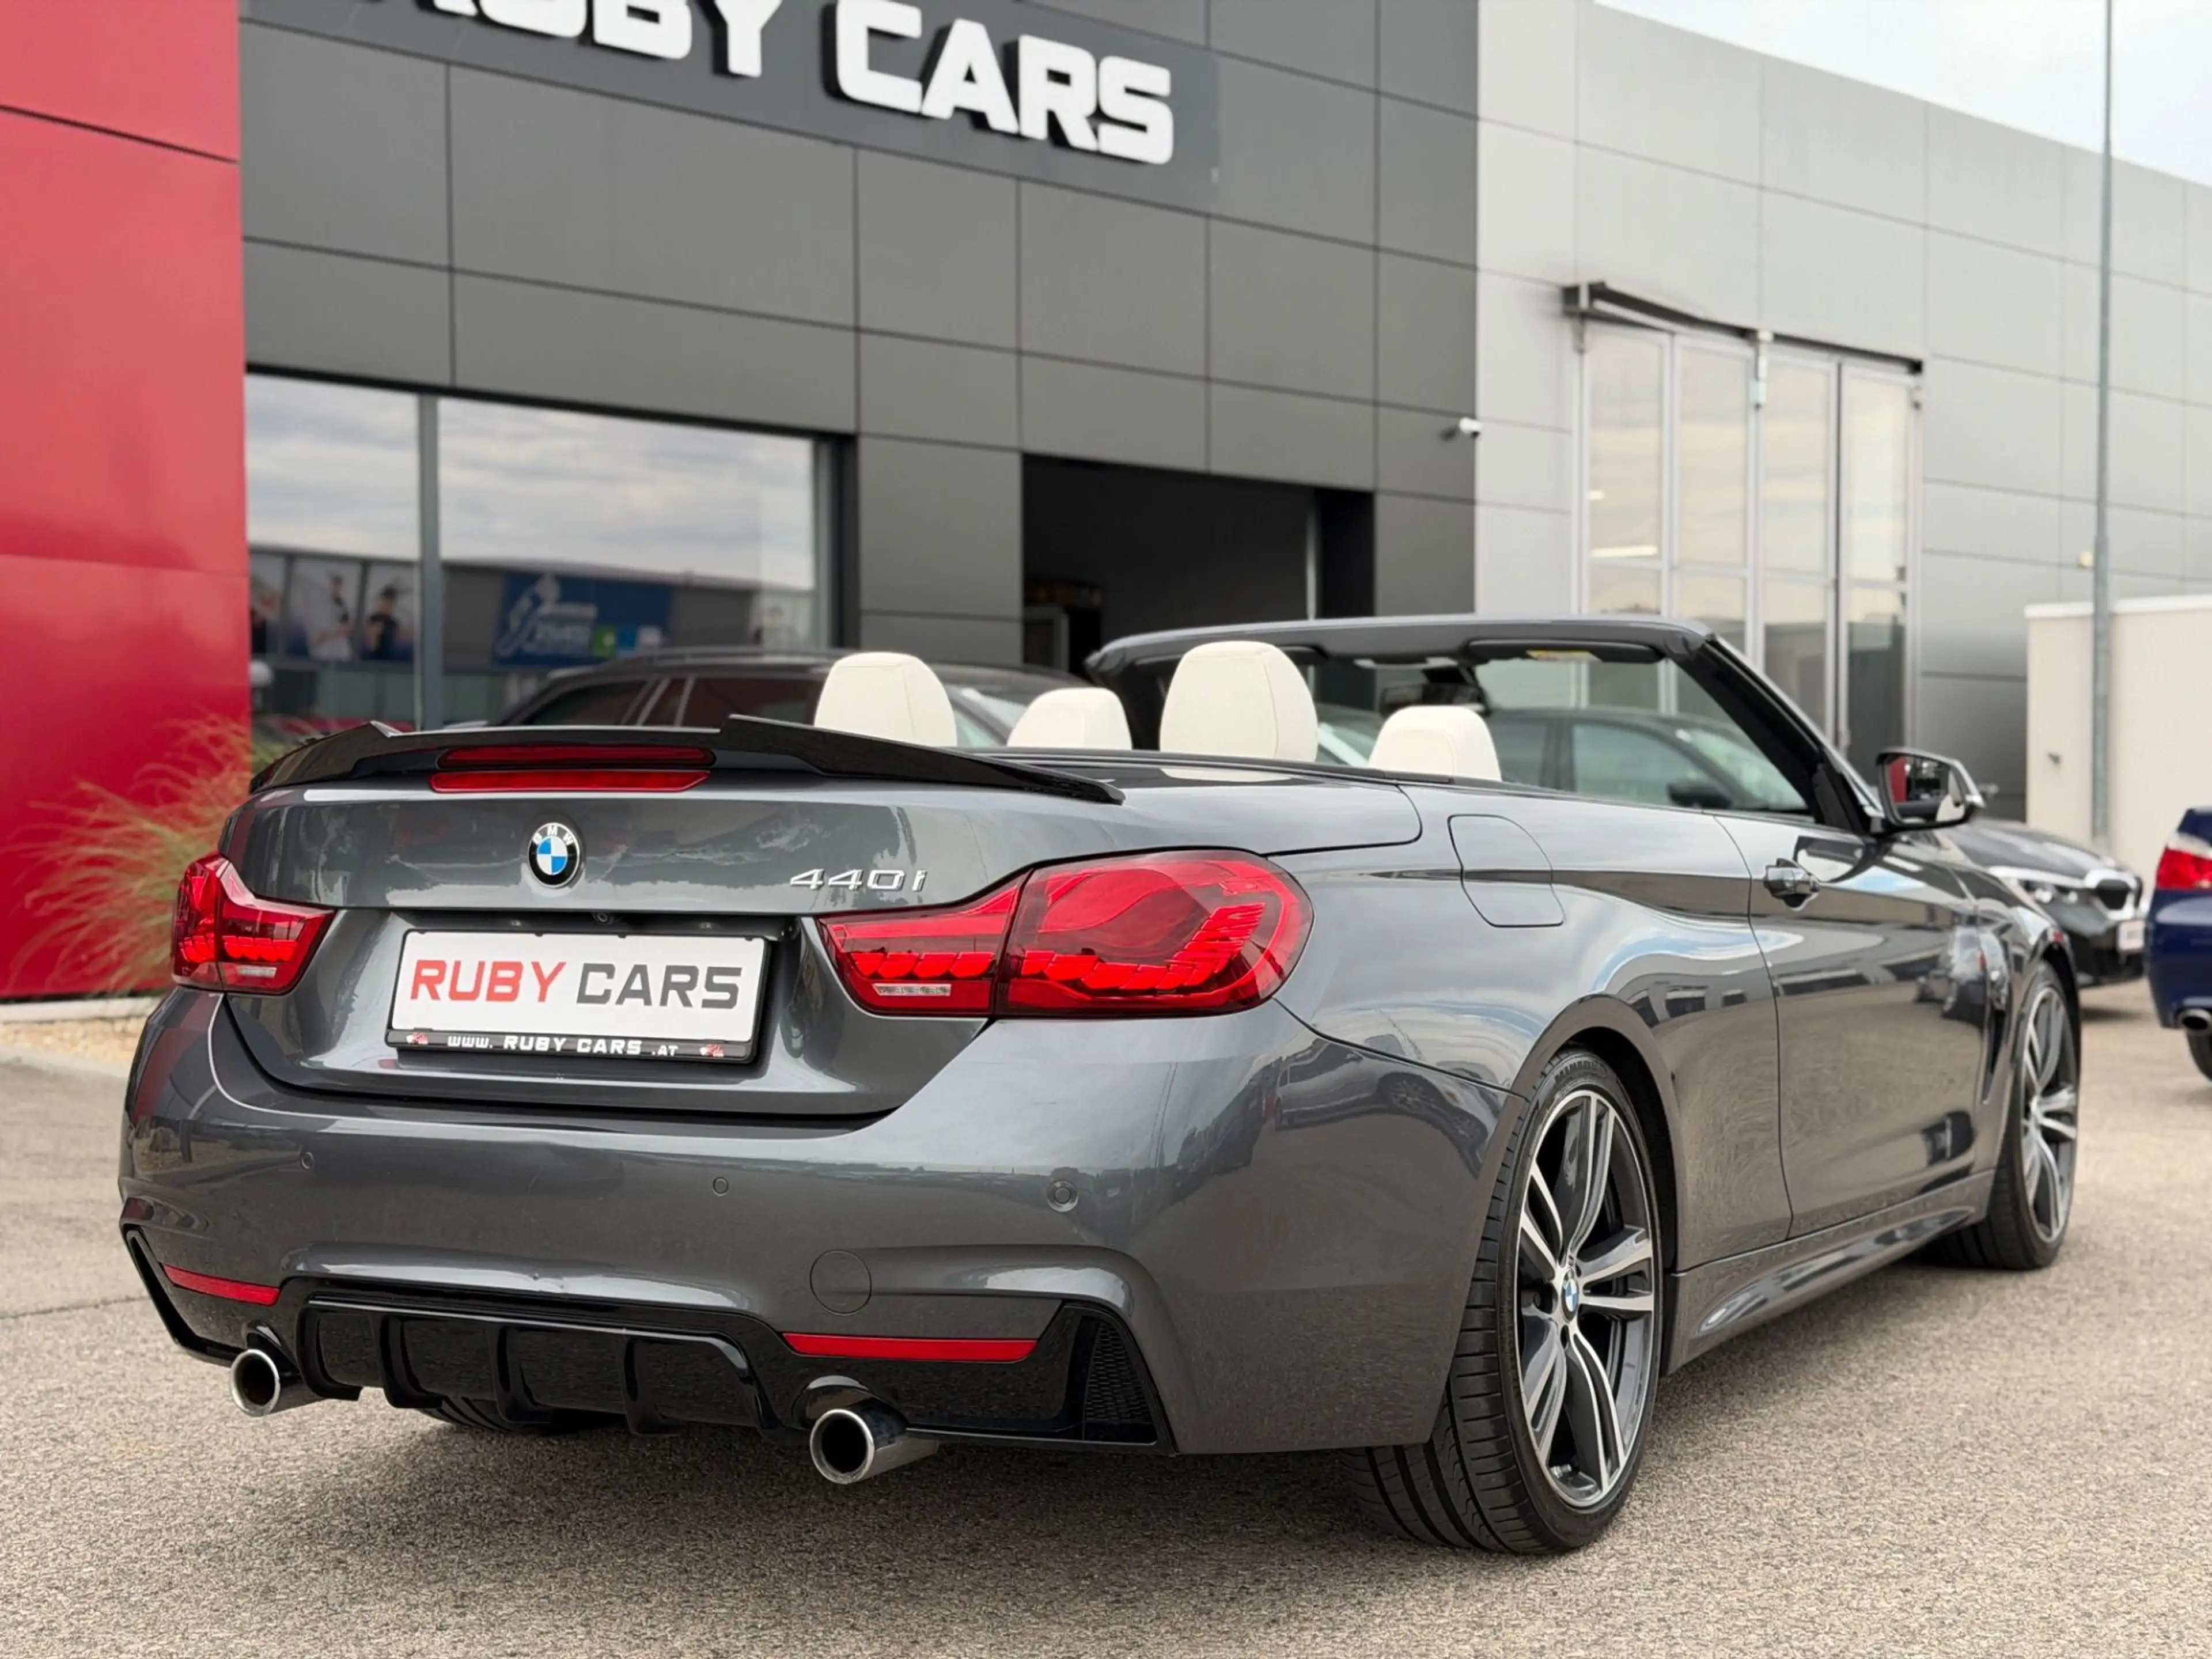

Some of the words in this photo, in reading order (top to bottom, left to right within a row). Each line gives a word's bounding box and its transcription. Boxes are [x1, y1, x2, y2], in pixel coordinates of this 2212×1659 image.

[830, 0, 1173, 164] CARS
[790, 868, 927, 892] 440i
[410, 959, 567, 1002] RUBY
[576, 963, 743, 1009] CARS
[503, 1035, 567, 1052] RUBY
[577, 1039, 642, 1055] CARS
